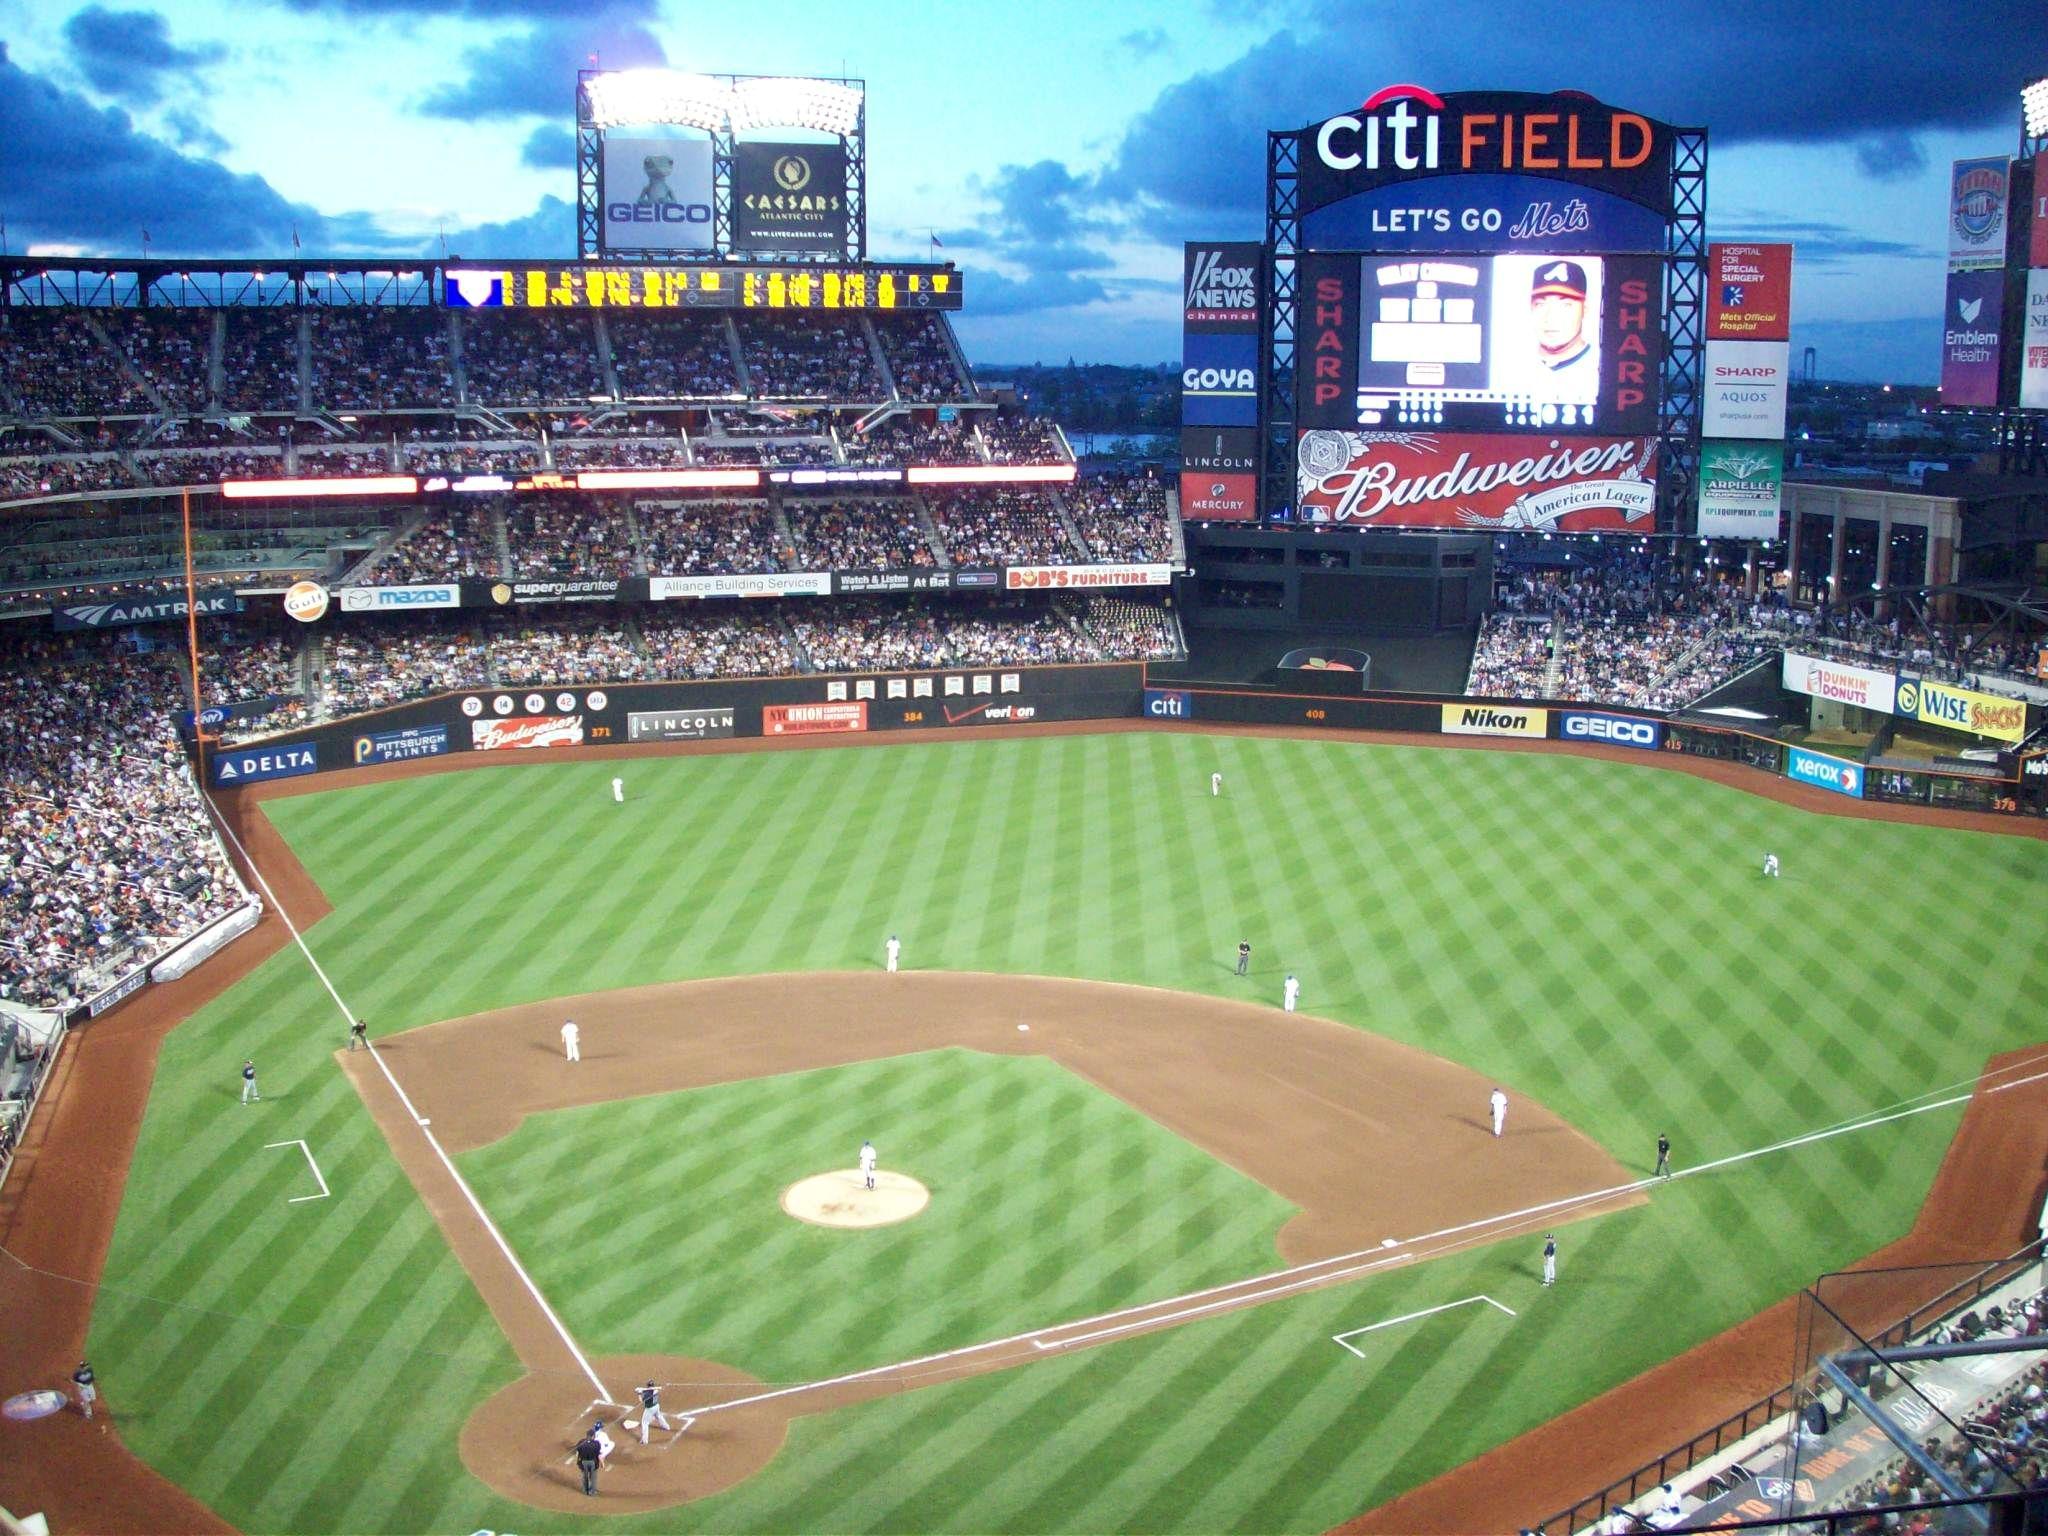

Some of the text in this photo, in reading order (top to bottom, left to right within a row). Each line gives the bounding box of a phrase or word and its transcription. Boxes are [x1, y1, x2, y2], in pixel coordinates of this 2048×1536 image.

[1316, 101, 1653, 170] citi FIELD
[744, 194, 839, 211] CAESARS
[607, 202, 711, 223] GEICO
[760, 212, 824, 221] ATLANTIC CITY
[1372, 199, 1590, 239] LET'S GO Mets
[1722, 247, 1761, 256] HOSPITAL
[1721, 256, 1738, 264] FOR
[1721, 265, 1759, 273] SPECIAL
[1209, 267, 1255, 288] FOX
[1721, 274, 1765, 282] SURGERY
[1195, 289, 1256, 308] NEWS
[1187, 312, 1256, 320] channel
[1720, 312, 1776, 322] Mets Official
[1719, 322, 1757, 331] Hospital
[1315, 278, 1344, 406] SHARP
[1945, 330, 1998, 345] Emblem
[1617, 280, 1648, 412] SHARP
[1951, 347, 1991, 362] Health
[1182, 368, 1254, 390] GOYA
[1715, 367, 1776, 377] SHARP
[1720, 392, 1767, 403] AQUOS
[1185, 457, 1253, 467] LINCOLN
[1317, 440, 1635, 521] Budweiser
[1708, 481, 1776, 490] ARPIELLE
[1192, 500, 1244, 510] MERCURY
[1533, 486, 1649, 519] American Lager
[664, 577, 818, 592] Alliance Building Services
[841, 574, 909, 585] Watch & Listen
[914, 576, 950, 587] At Bat
[1072, 573, 1148, 586] FURNITURE
[514, 581, 619, 597] superguarantee
[288, 593, 323, 611] Gulf
[379, 590, 451, 605] mazda
[110, 598, 227, 622] AMTRAK
[1823, 671, 1870, 690] DUNKIN'
[560, 697, 572, 706] 42
[1823, 684, 1867, 704] DONUTS
[467, 702, 478, 711] 37
[788, 706, 822, 720] UNION
[985, 706, 1034, 721] verizon
[1152, 698, 1182, 716] citi
[1924, 688, 2023, 730] WISE SNACKS
[904, 711, 922, 721] 384
[1306, 710, 1324, 719] 408
[1461, 708, 1527, 729] Nikon
[641, 716, 734, 731] LINCOLN
[1566, 717, 1654, 743] GEICO
[480, 716, 577, 750] Budweiser
[376, 734, 446, 752] PITTSBURGH
[1665, 739, 1681, 750] 415
[384, 745, 438, 760] PAINTS
[243, 751, 314, 774] DELTA
[1796, 757, 1839, 784] xerox
[1993, 798, 2016, 811] 378
